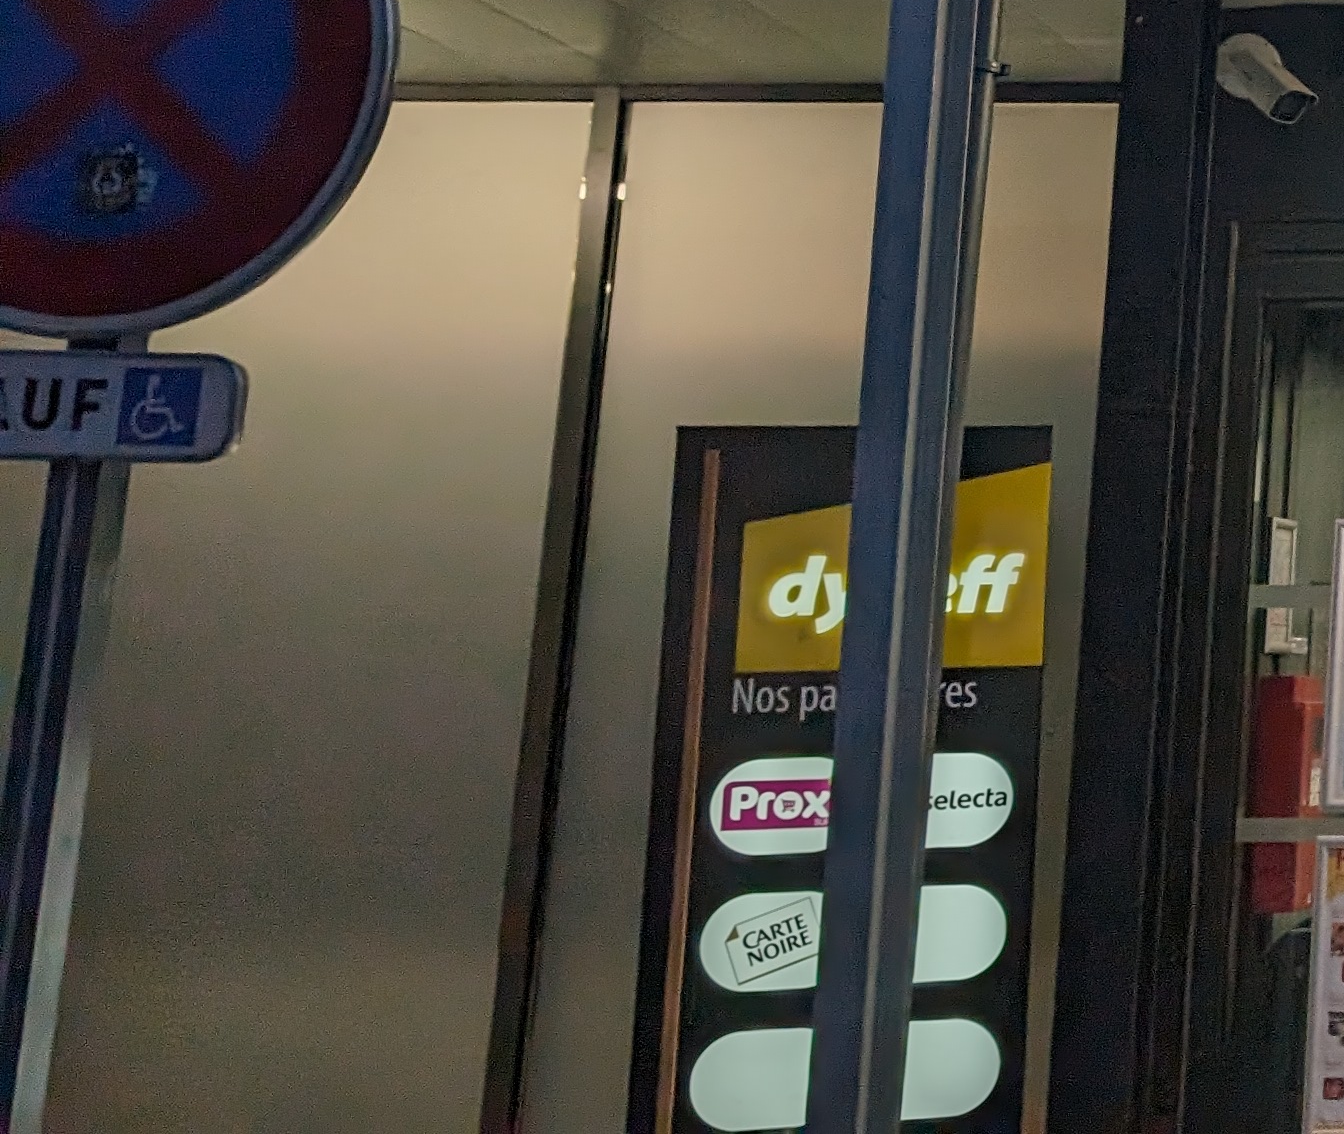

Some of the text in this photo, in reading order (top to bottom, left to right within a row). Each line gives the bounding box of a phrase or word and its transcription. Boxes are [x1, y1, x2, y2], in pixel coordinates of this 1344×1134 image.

[0, 377, 109, 432] UF
[767, 552, 1025, 635] dyff
[732, 678, 790, 715] Nos
[729, 786, 831, 821] Prox
[742, 913, 809, 949] CARTE
[746, 929, 813, 967] NOIRE
